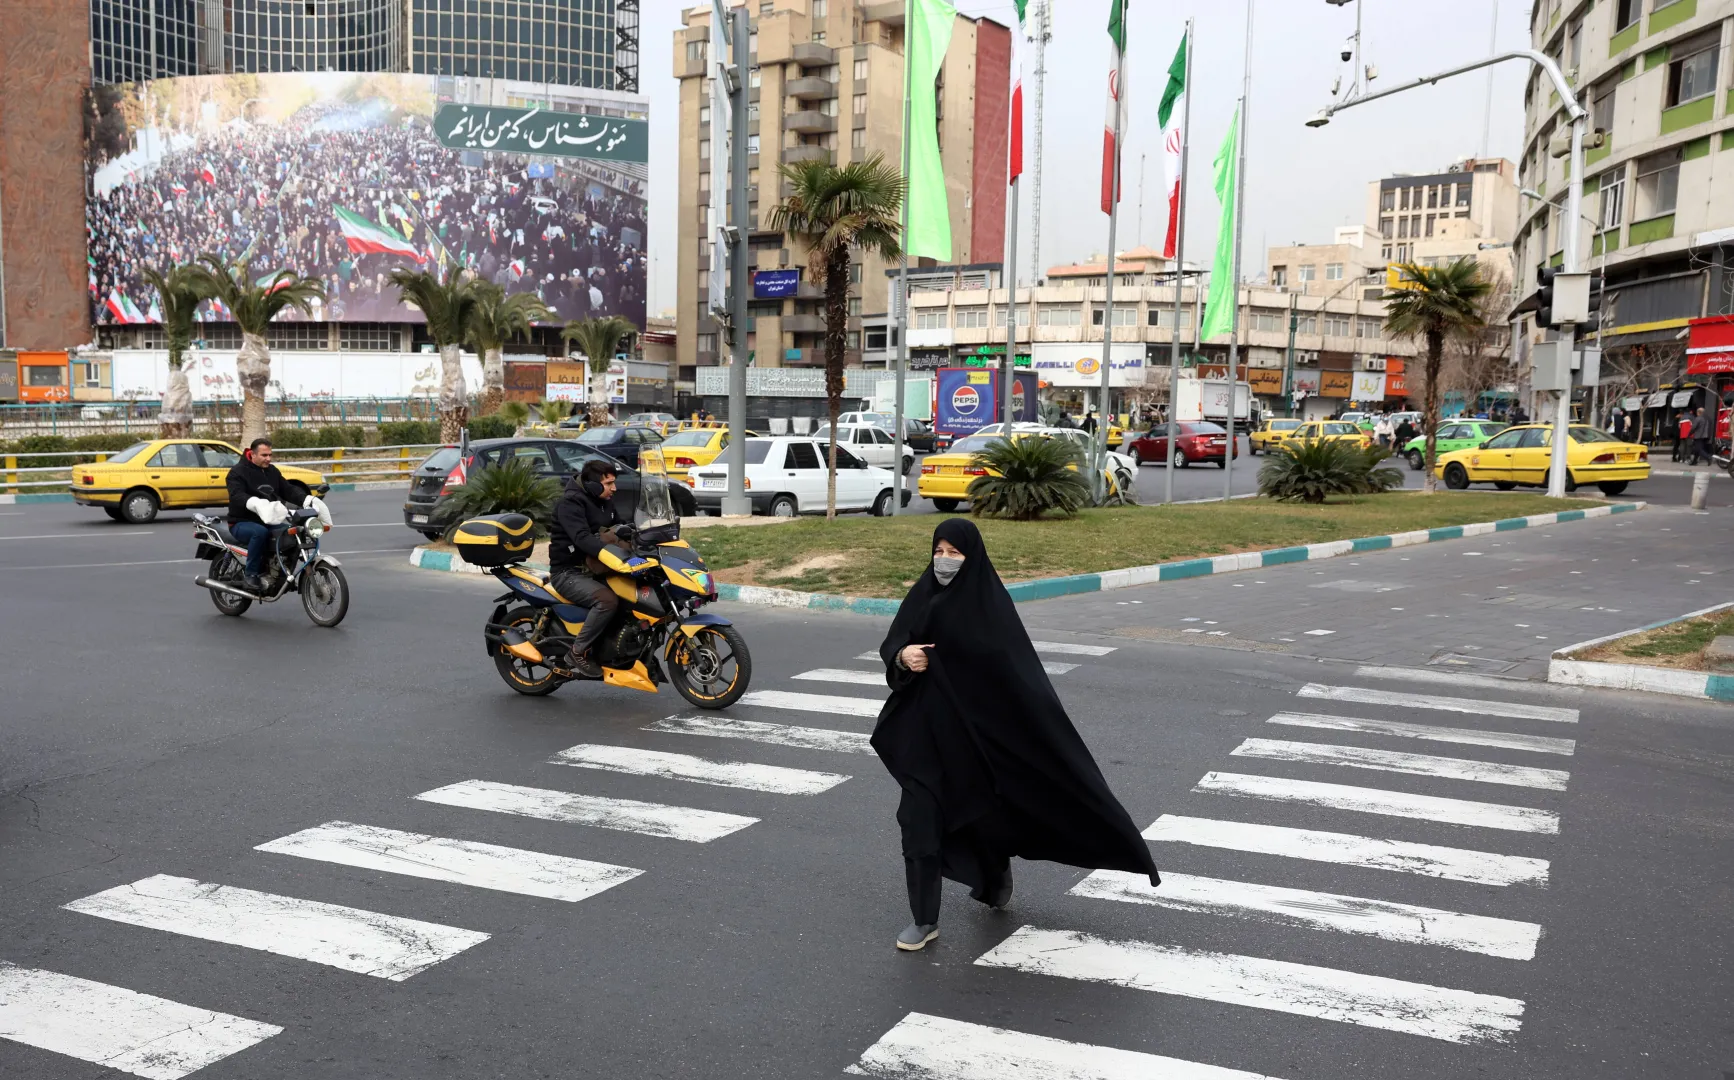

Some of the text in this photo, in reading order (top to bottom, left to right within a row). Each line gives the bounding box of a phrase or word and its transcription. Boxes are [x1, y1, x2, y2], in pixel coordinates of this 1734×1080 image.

[448, 106, 491, 148] ایرانم
[480, 118, 511, 148] من
[507, 106, 540, 140] که
[1035, 361, 1075, 369] MELLI
[1118, 359, 1142, 370] کفش
